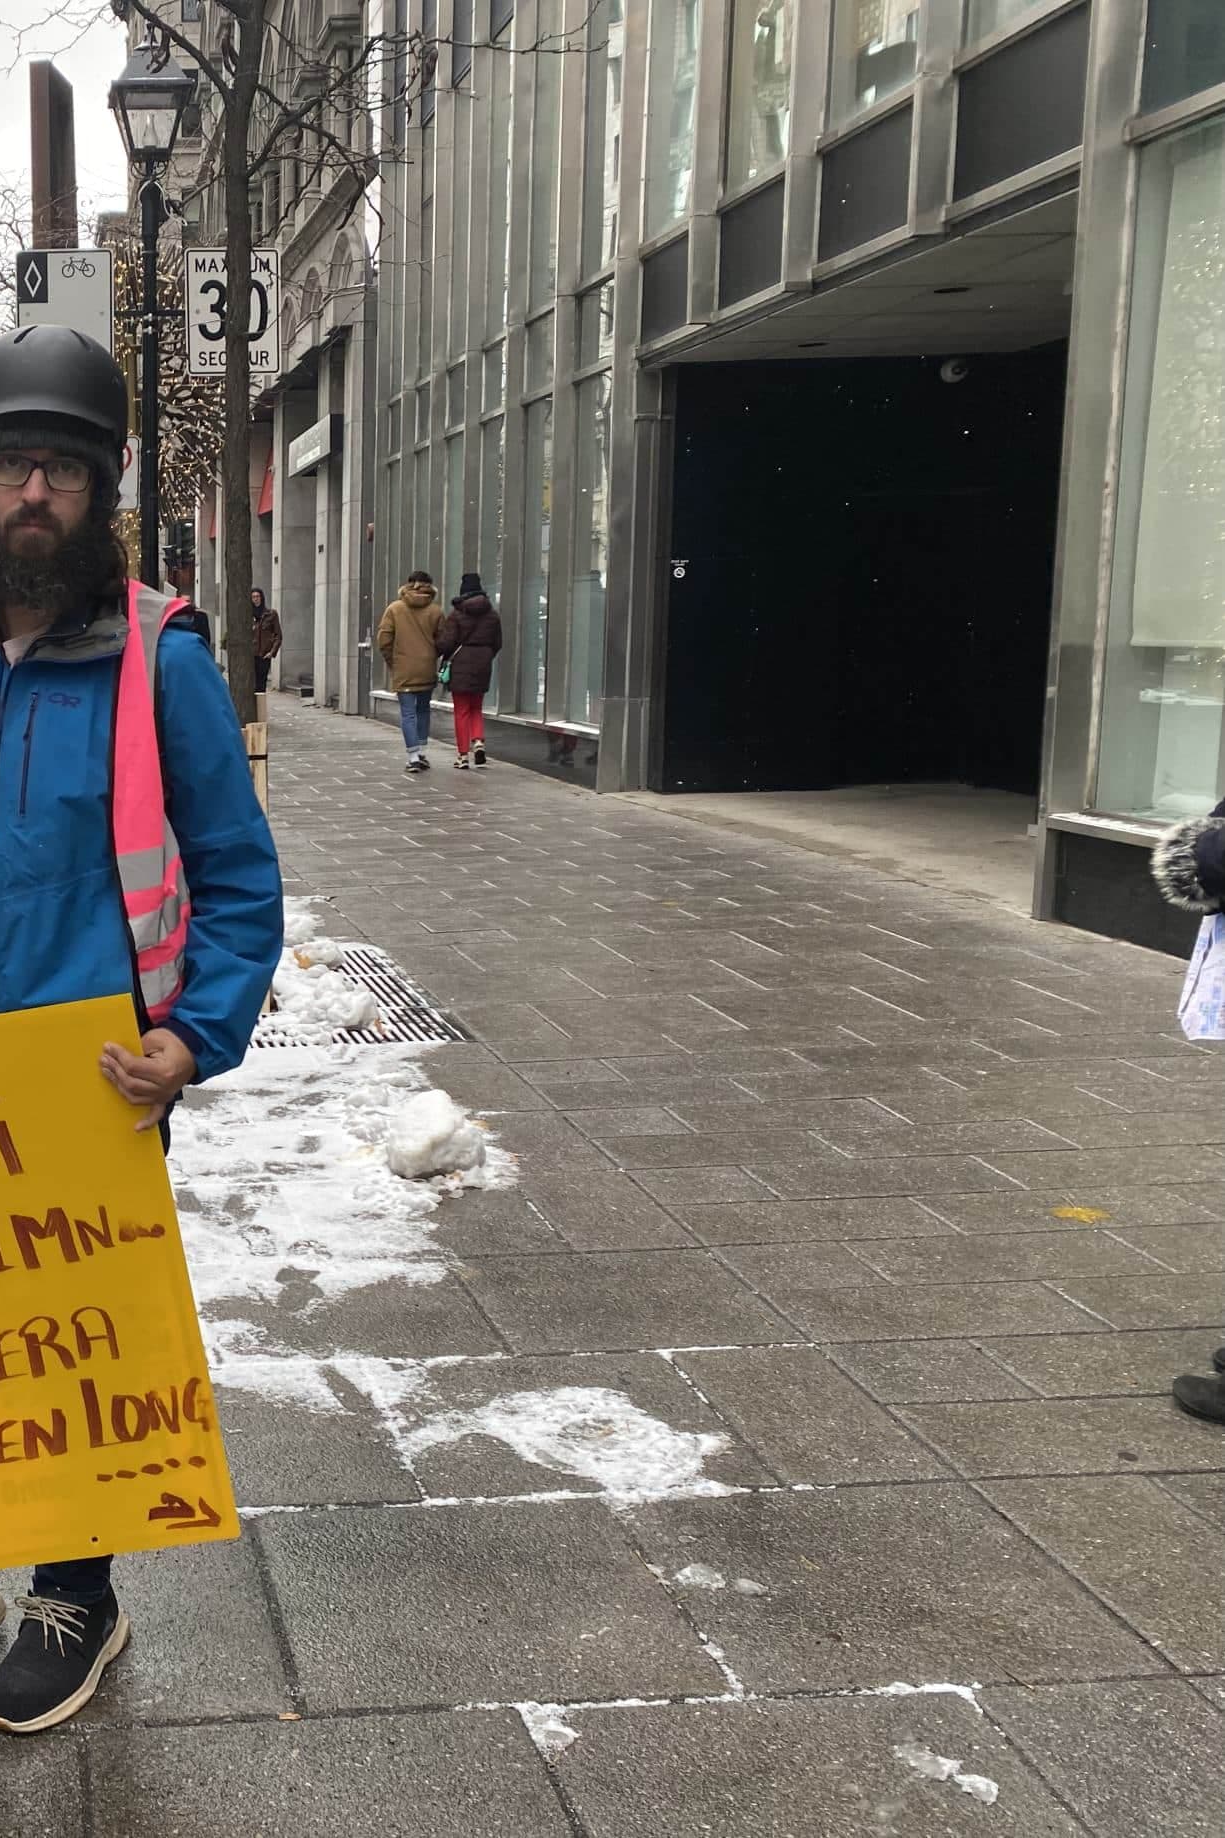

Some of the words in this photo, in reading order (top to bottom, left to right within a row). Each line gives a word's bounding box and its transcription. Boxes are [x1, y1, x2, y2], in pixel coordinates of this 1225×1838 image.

[195, 258, 270, 272] MAXUM
[199, 279, 268, 341] 30
[198, 351, 269, 366] SECUR
[80, 1377, 210, 1449] LONG
